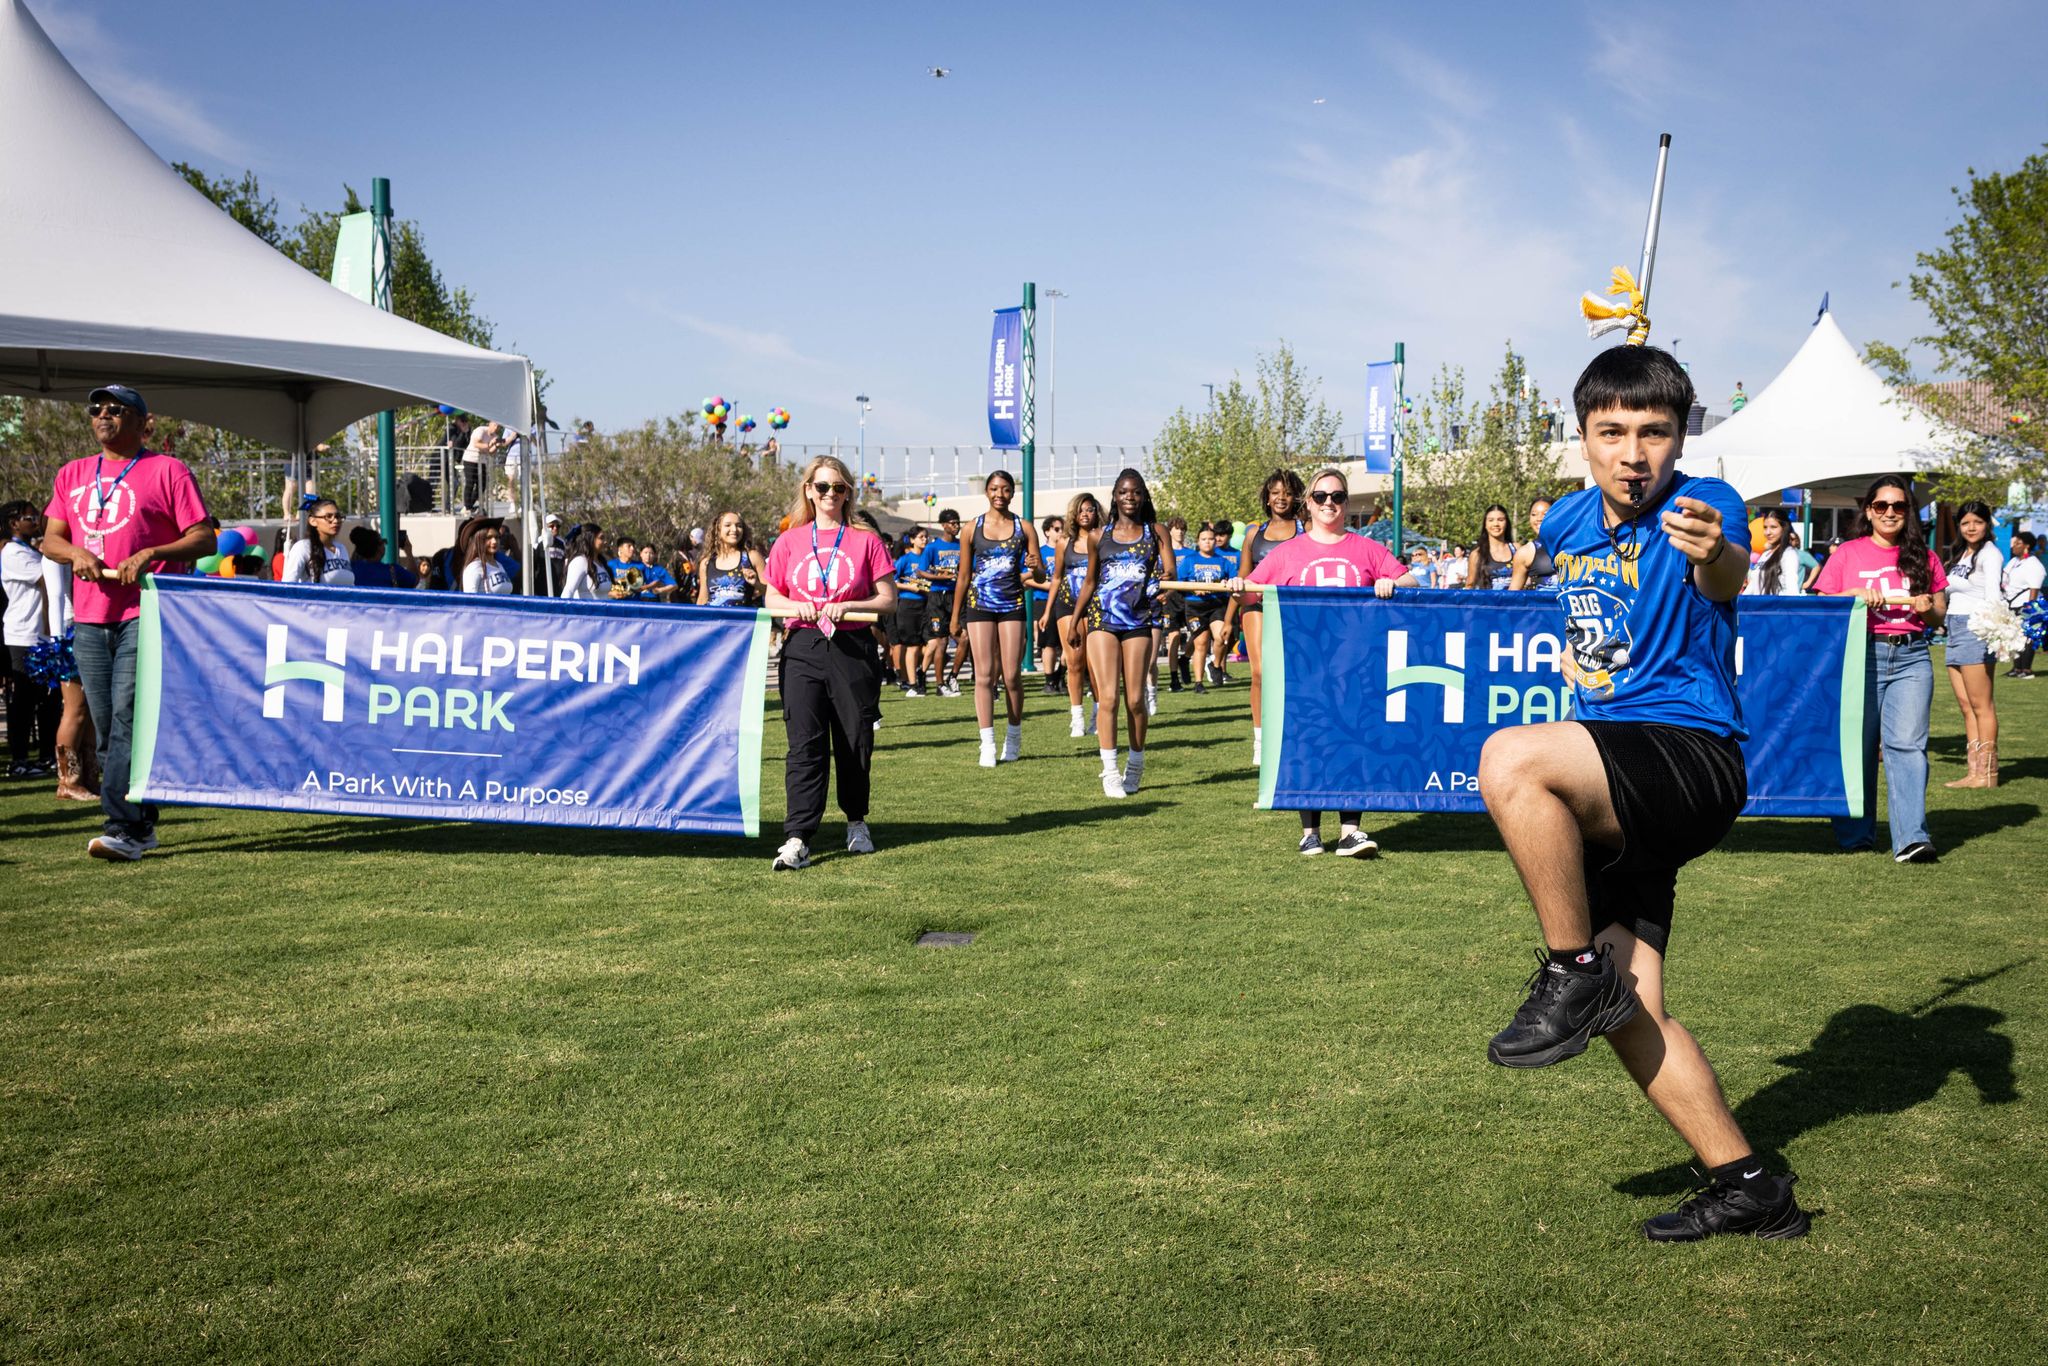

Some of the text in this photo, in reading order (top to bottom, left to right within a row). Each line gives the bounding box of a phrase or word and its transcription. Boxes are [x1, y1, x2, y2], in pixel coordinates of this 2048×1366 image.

[994, 338, 1006, 397] HALPERIN
[1004, 363, 1015, 397] PARK
[1568, 593, 1602, 617] BIG
[370, 629, 641, 686] HALPERIN
[1488, 632, 1562, 673] HA
[368, 683, 515, 733] PARK
[301, 770, 589, 808] A Park With A Purpose
[1424, 771, 1479, 792] A Pa
